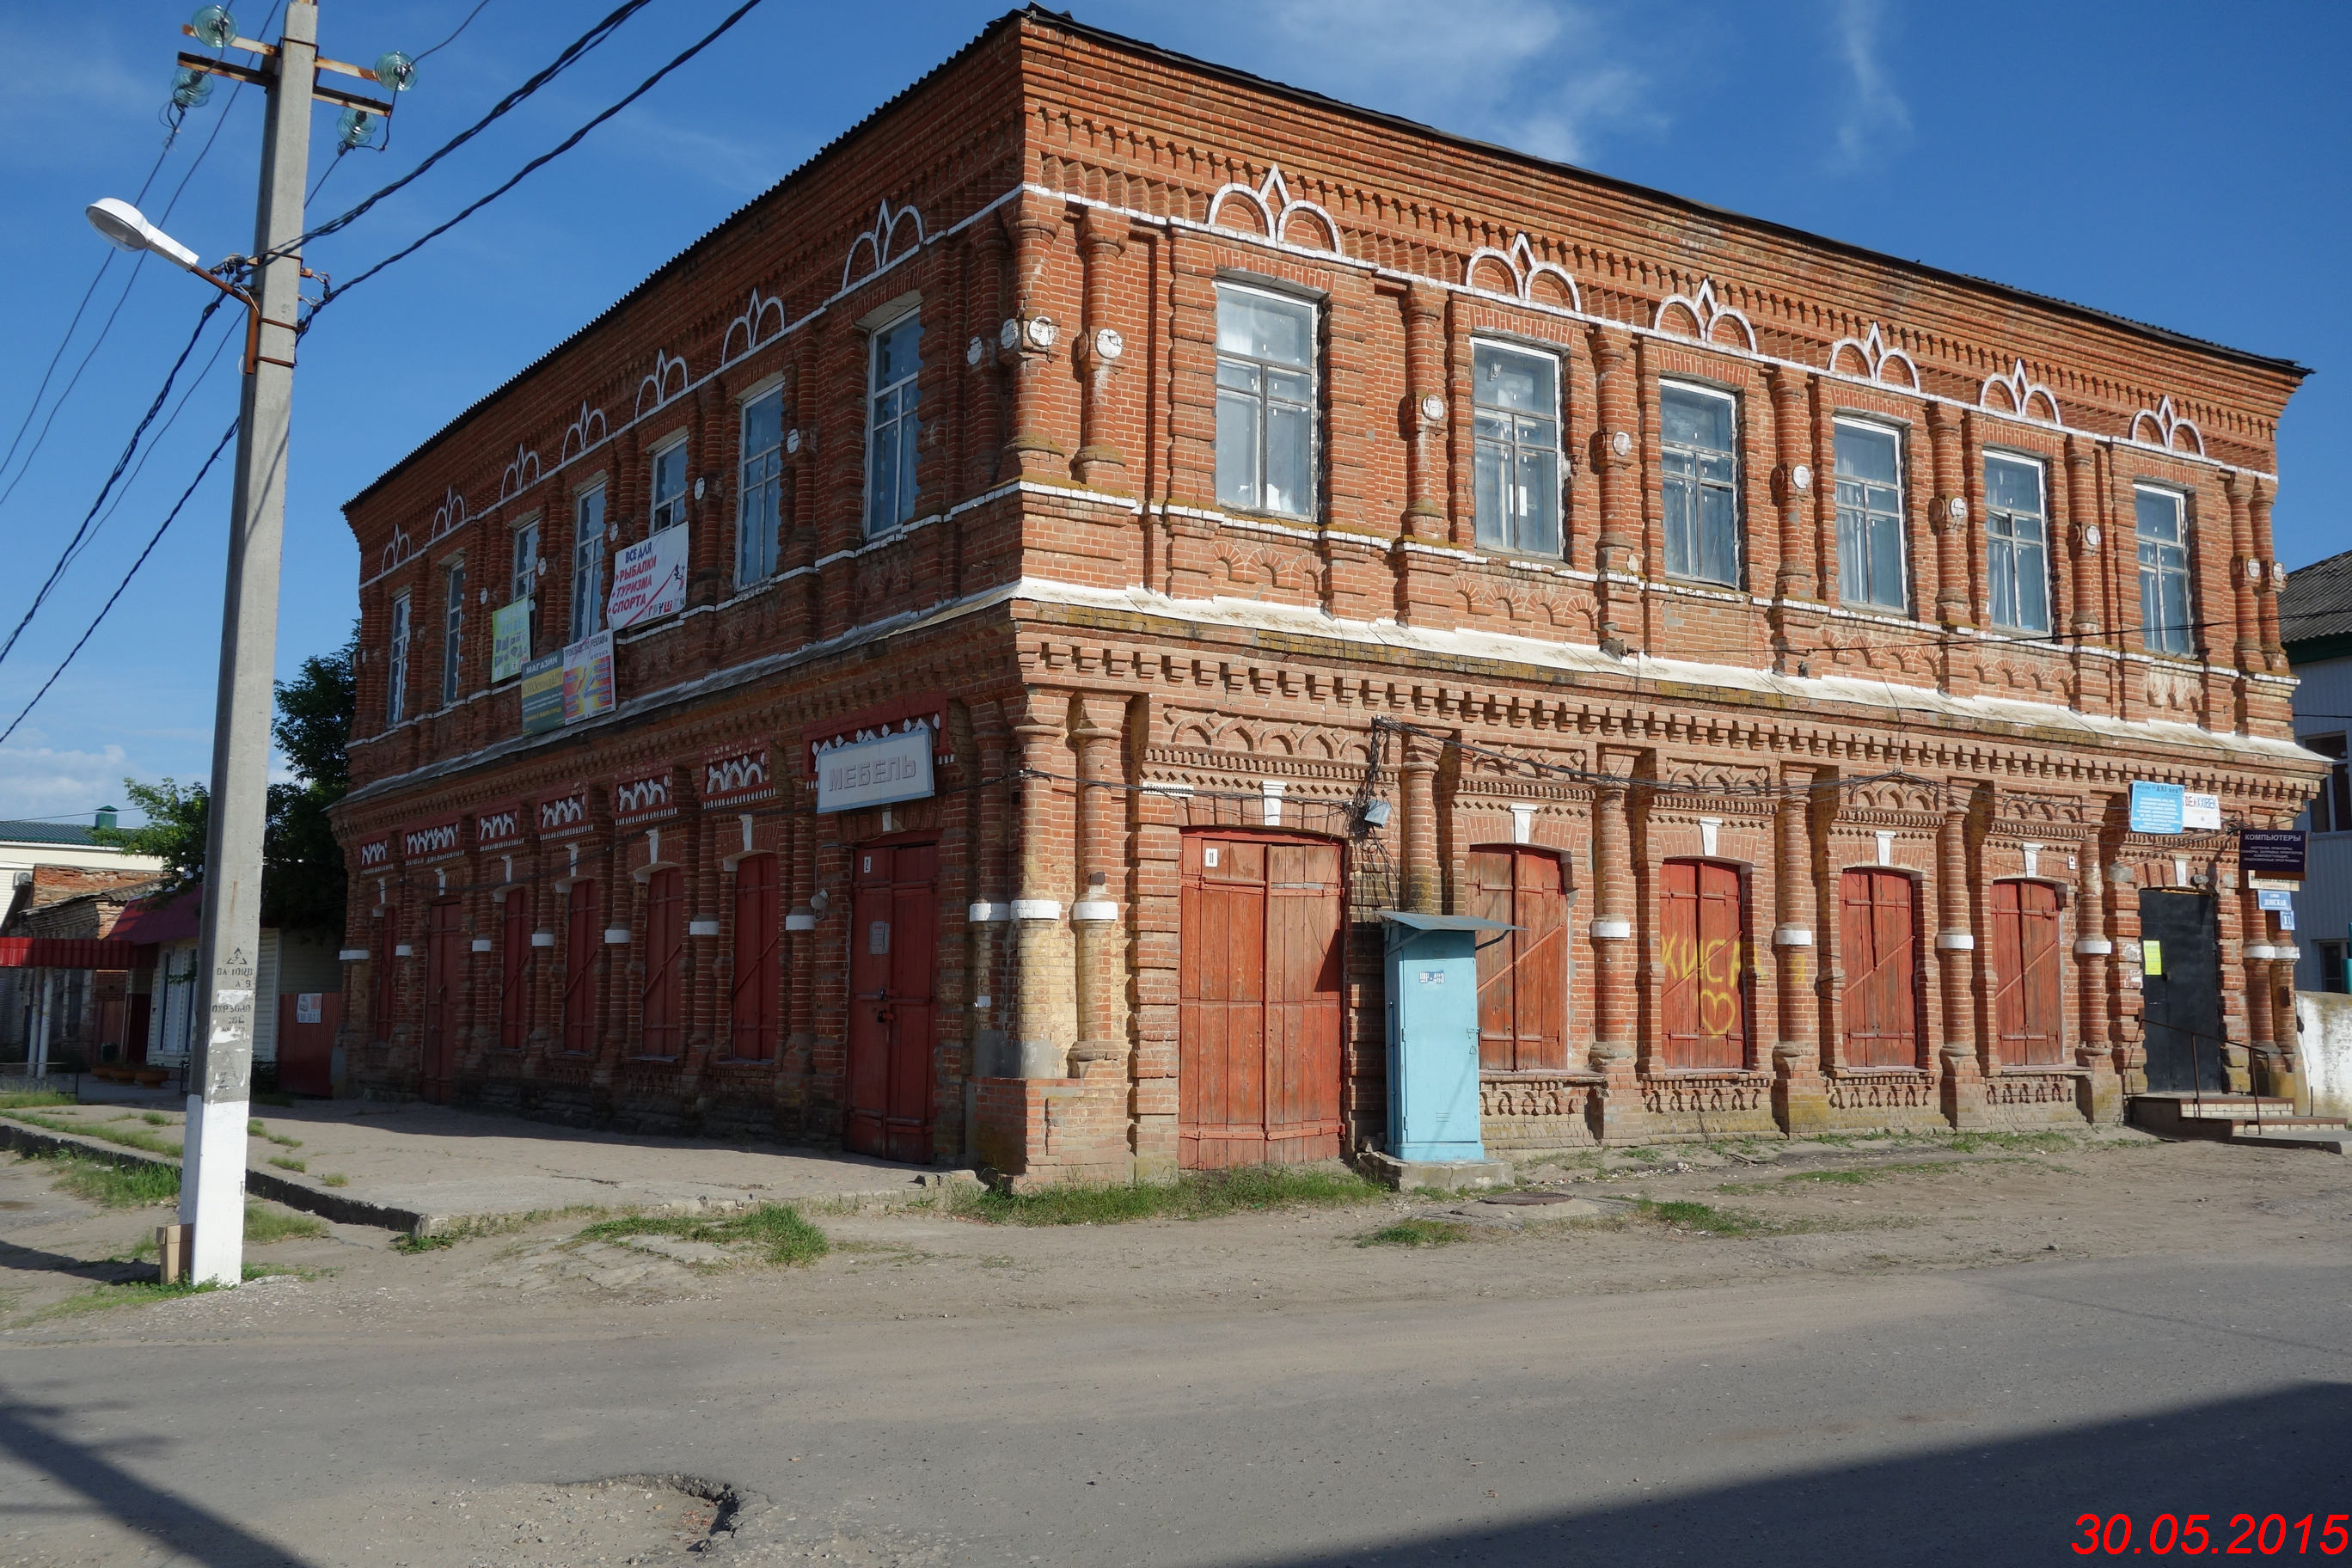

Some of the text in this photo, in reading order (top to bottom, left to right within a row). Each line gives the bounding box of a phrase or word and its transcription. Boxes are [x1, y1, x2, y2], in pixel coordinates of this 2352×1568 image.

[625, 542, 652, 564] ВСЕ ДЛЯ
[619, 555, 658, 583] РЫБАЛКИ
[616, 574, 652, 598] ТУРИЗМА
[612, 593, 646, 616] СПОРТА
[526, 656, 558, 675] МАГАЗИН
[828, 756, 916, 792] МЕБЕЛЬ
[2245, 833, 2301, 842] КОМПЬЮТЕРЫ
